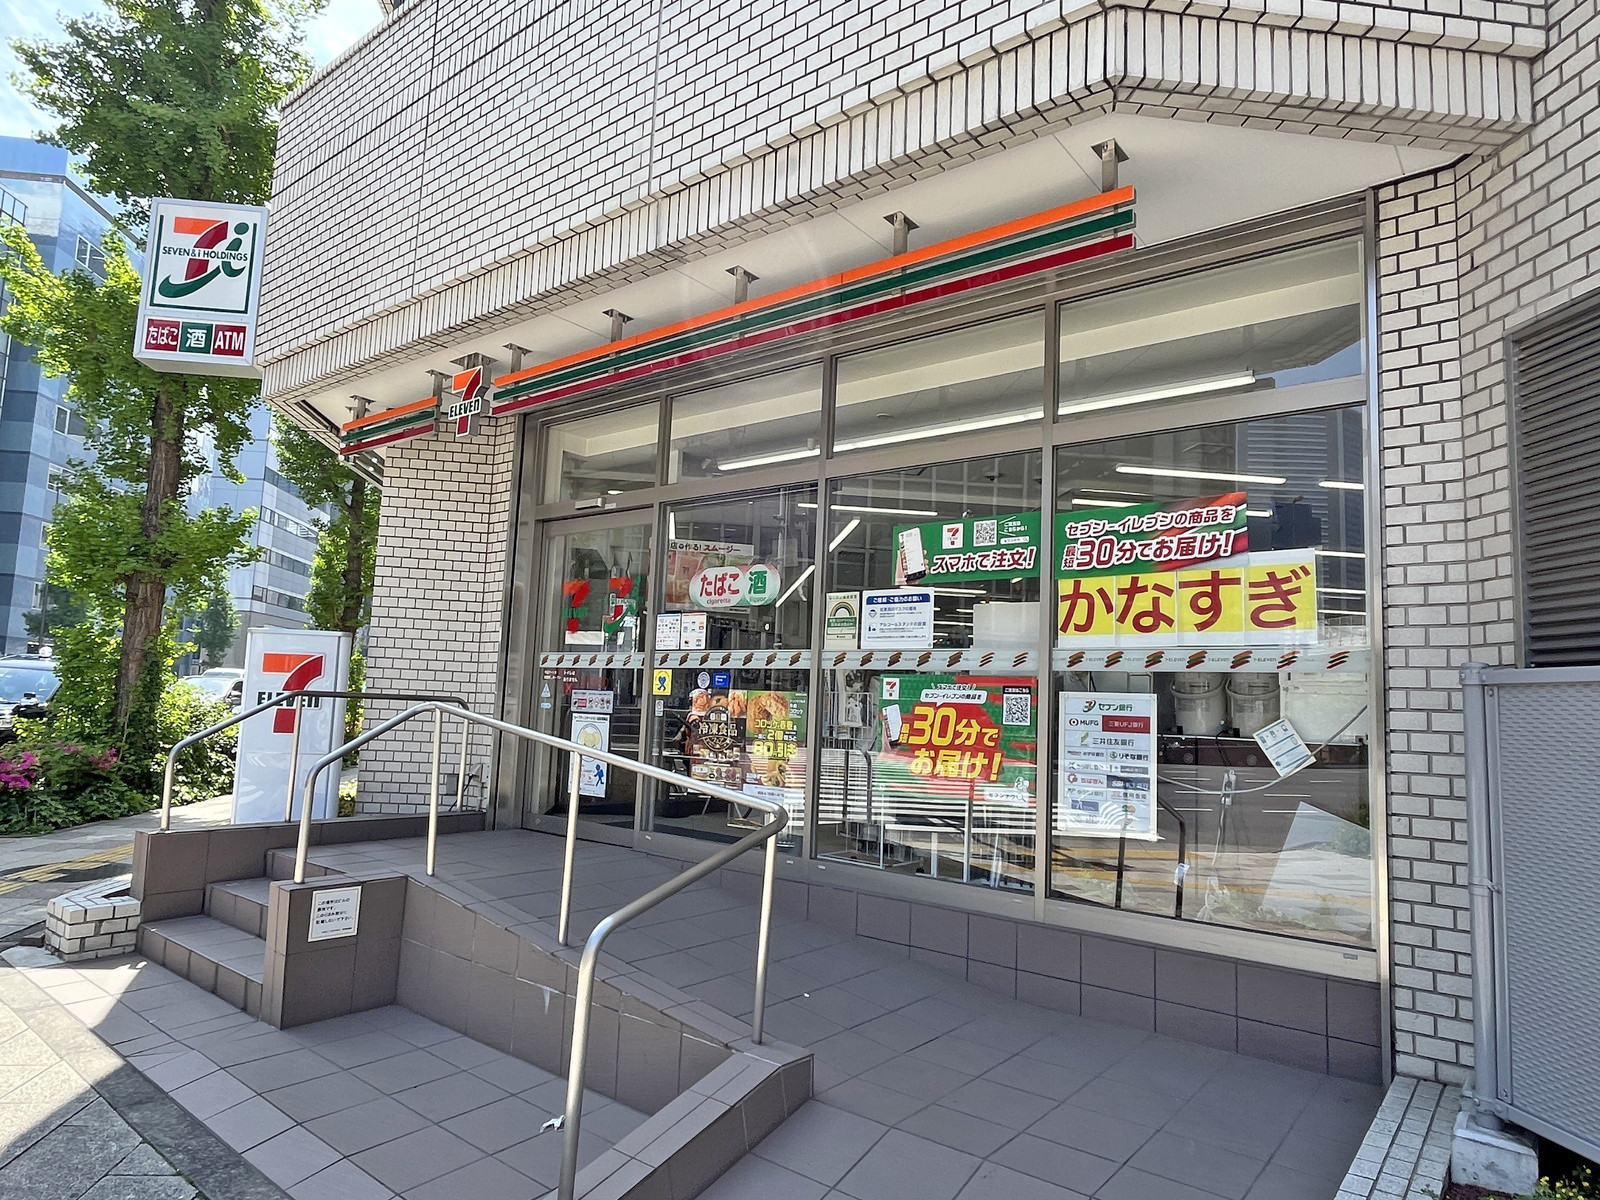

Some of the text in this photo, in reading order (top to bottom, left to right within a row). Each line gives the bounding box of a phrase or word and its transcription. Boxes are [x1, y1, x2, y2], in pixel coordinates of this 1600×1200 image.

[203, 250, 248, 262] HOLDINGS
[146, 326, 245, 350] たばこ 酒 ATM
[700, 570, 768, 597] たばこ 酒
[706, 597, 732, 605] cigarette
[1059, 565, 1312, 634] かなすぎ
[1098, 703, 1133, 712] セブン銀行
[698, 722, 738, 737] 冷凍食品
[908, 706, 999, 747] 30分で
[1092, 737, 1135, 747] 三井住友銀行
[909, 747, 1002, 781] お届け!
[1118, 753, 1149, 761] りそな銀行
